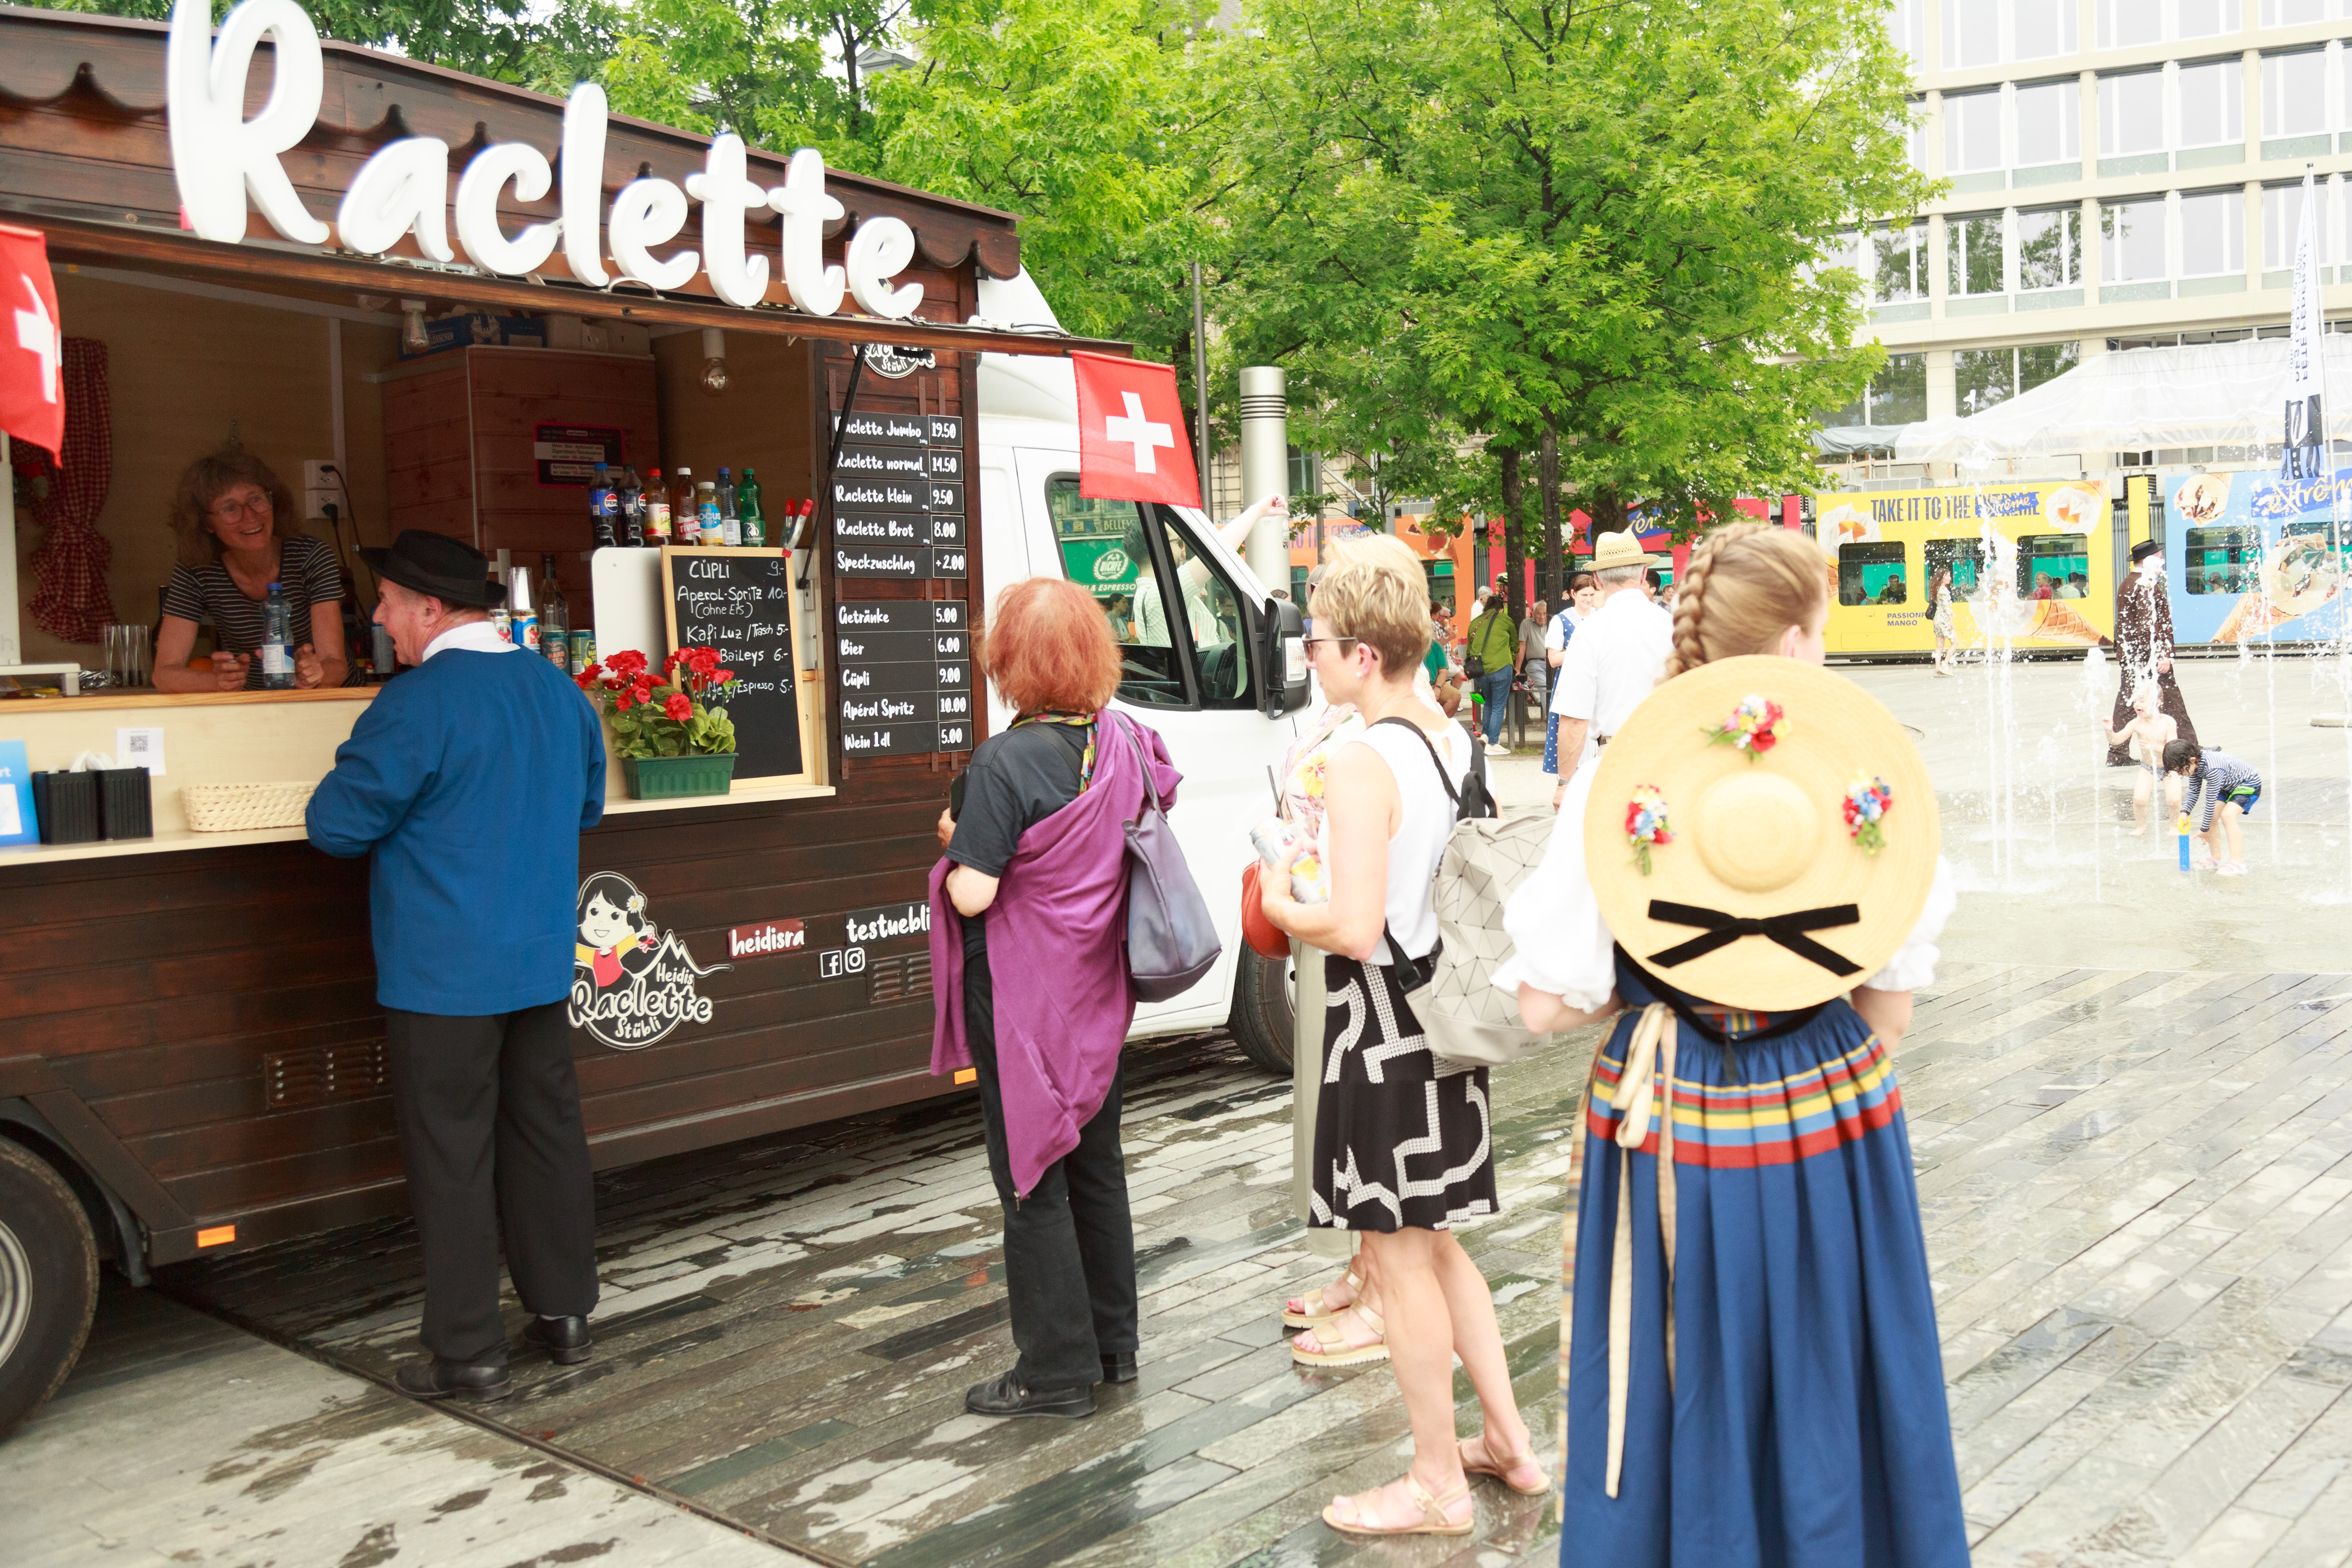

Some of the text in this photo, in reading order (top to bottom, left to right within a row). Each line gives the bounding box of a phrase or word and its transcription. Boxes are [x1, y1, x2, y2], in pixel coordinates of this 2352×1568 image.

[167, 0, 924, 318] Raclette
[881, 358, 908, 372] Stübli
[886, 421, 921, 437] Jumbo
[932, 422, 956, 438] 19.50
[837, 451, 956, 473] Raclette normal 14.50
[836, 485, 953, 505] Raclette klein 9.50
[1871, 498, 1904, 522] TAKE
[1908, 497, 1921, 521] IT
[1923, 496, 1941, 521] TO
[1945, 495, 1971, 519] THE
[837, 518, 956, 538] Raclette Brot 8.00
[838, 551, 914, 574] Speckzuschlag
[1098, 584, 1136, 592] ESPRESSO
[839, 606, 957, 624] Getränke 5.00
[687, 624, 716, 645] Kafi
[721, 626, 742, 639] Luz
[841, 637, 959, 655] Bier 6.00
[843, 668, 960, 689] Cüpli 9.00
[843, 697, 966, 720] Apérol Spritz 10.00
[845, 734, 870, 750] Wein
[941, 728, 962, 744] 5.00
[732, 926, 804, 956] heidisra
[656, 962, 694, 986] Heidis
[568, 977, 713, 1028] Raclette
[615, 1016, 661, 1040] Stübli
